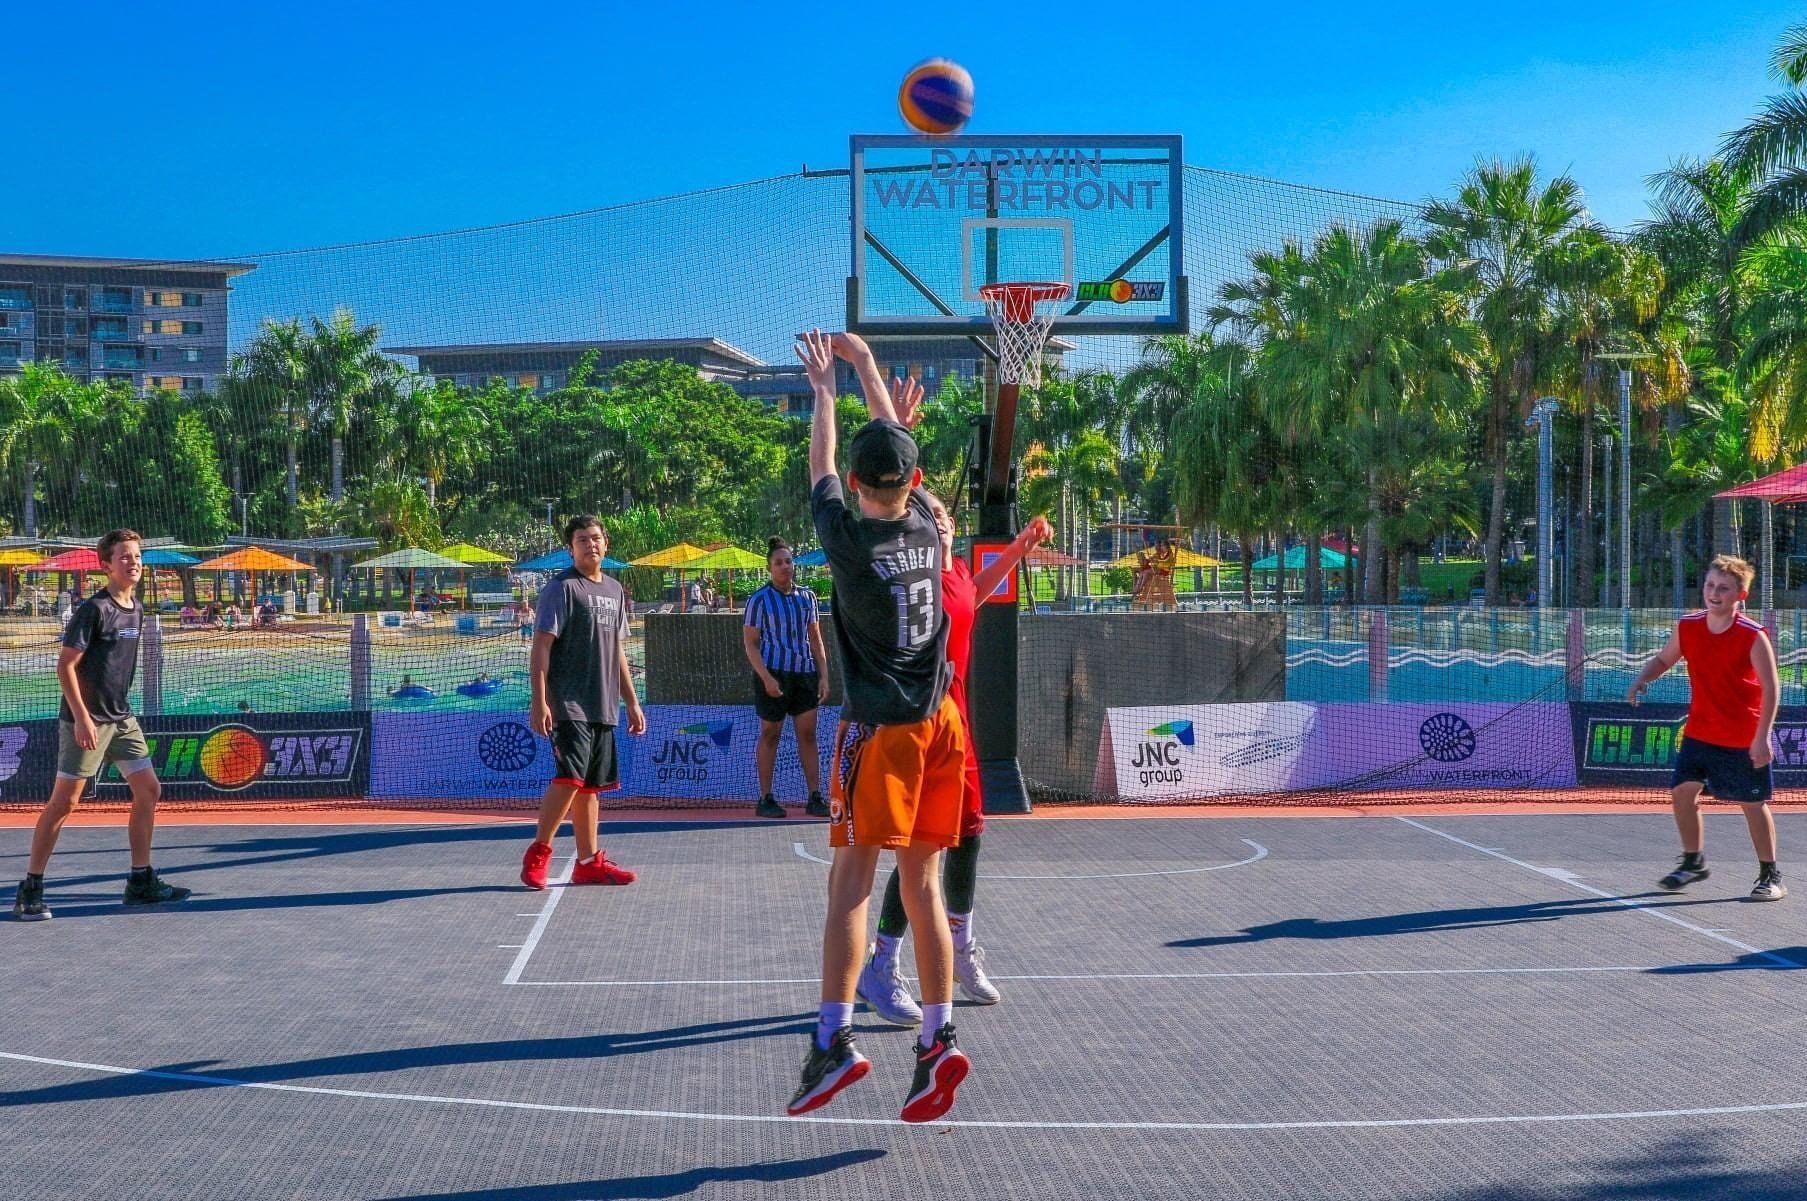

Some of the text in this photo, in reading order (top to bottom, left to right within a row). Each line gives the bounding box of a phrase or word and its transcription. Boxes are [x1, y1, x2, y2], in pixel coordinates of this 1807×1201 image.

[931, 148, 1102, 179] DARWIN
[873, 179, 1161, 210] WATERFRONT
[870, 547, 935, 581] HARDEN
[890, 578, 934, 648] 13
[652, 740, 710, 765] JNC
[1131, 741, 1180, 767] JNC
[484, 779, 552, 791] WATERF
[657, 767, 708, 784] group
[1139, 768, 1183, 787] group
[1429, 769, 1532, 781] WATERFRONT
